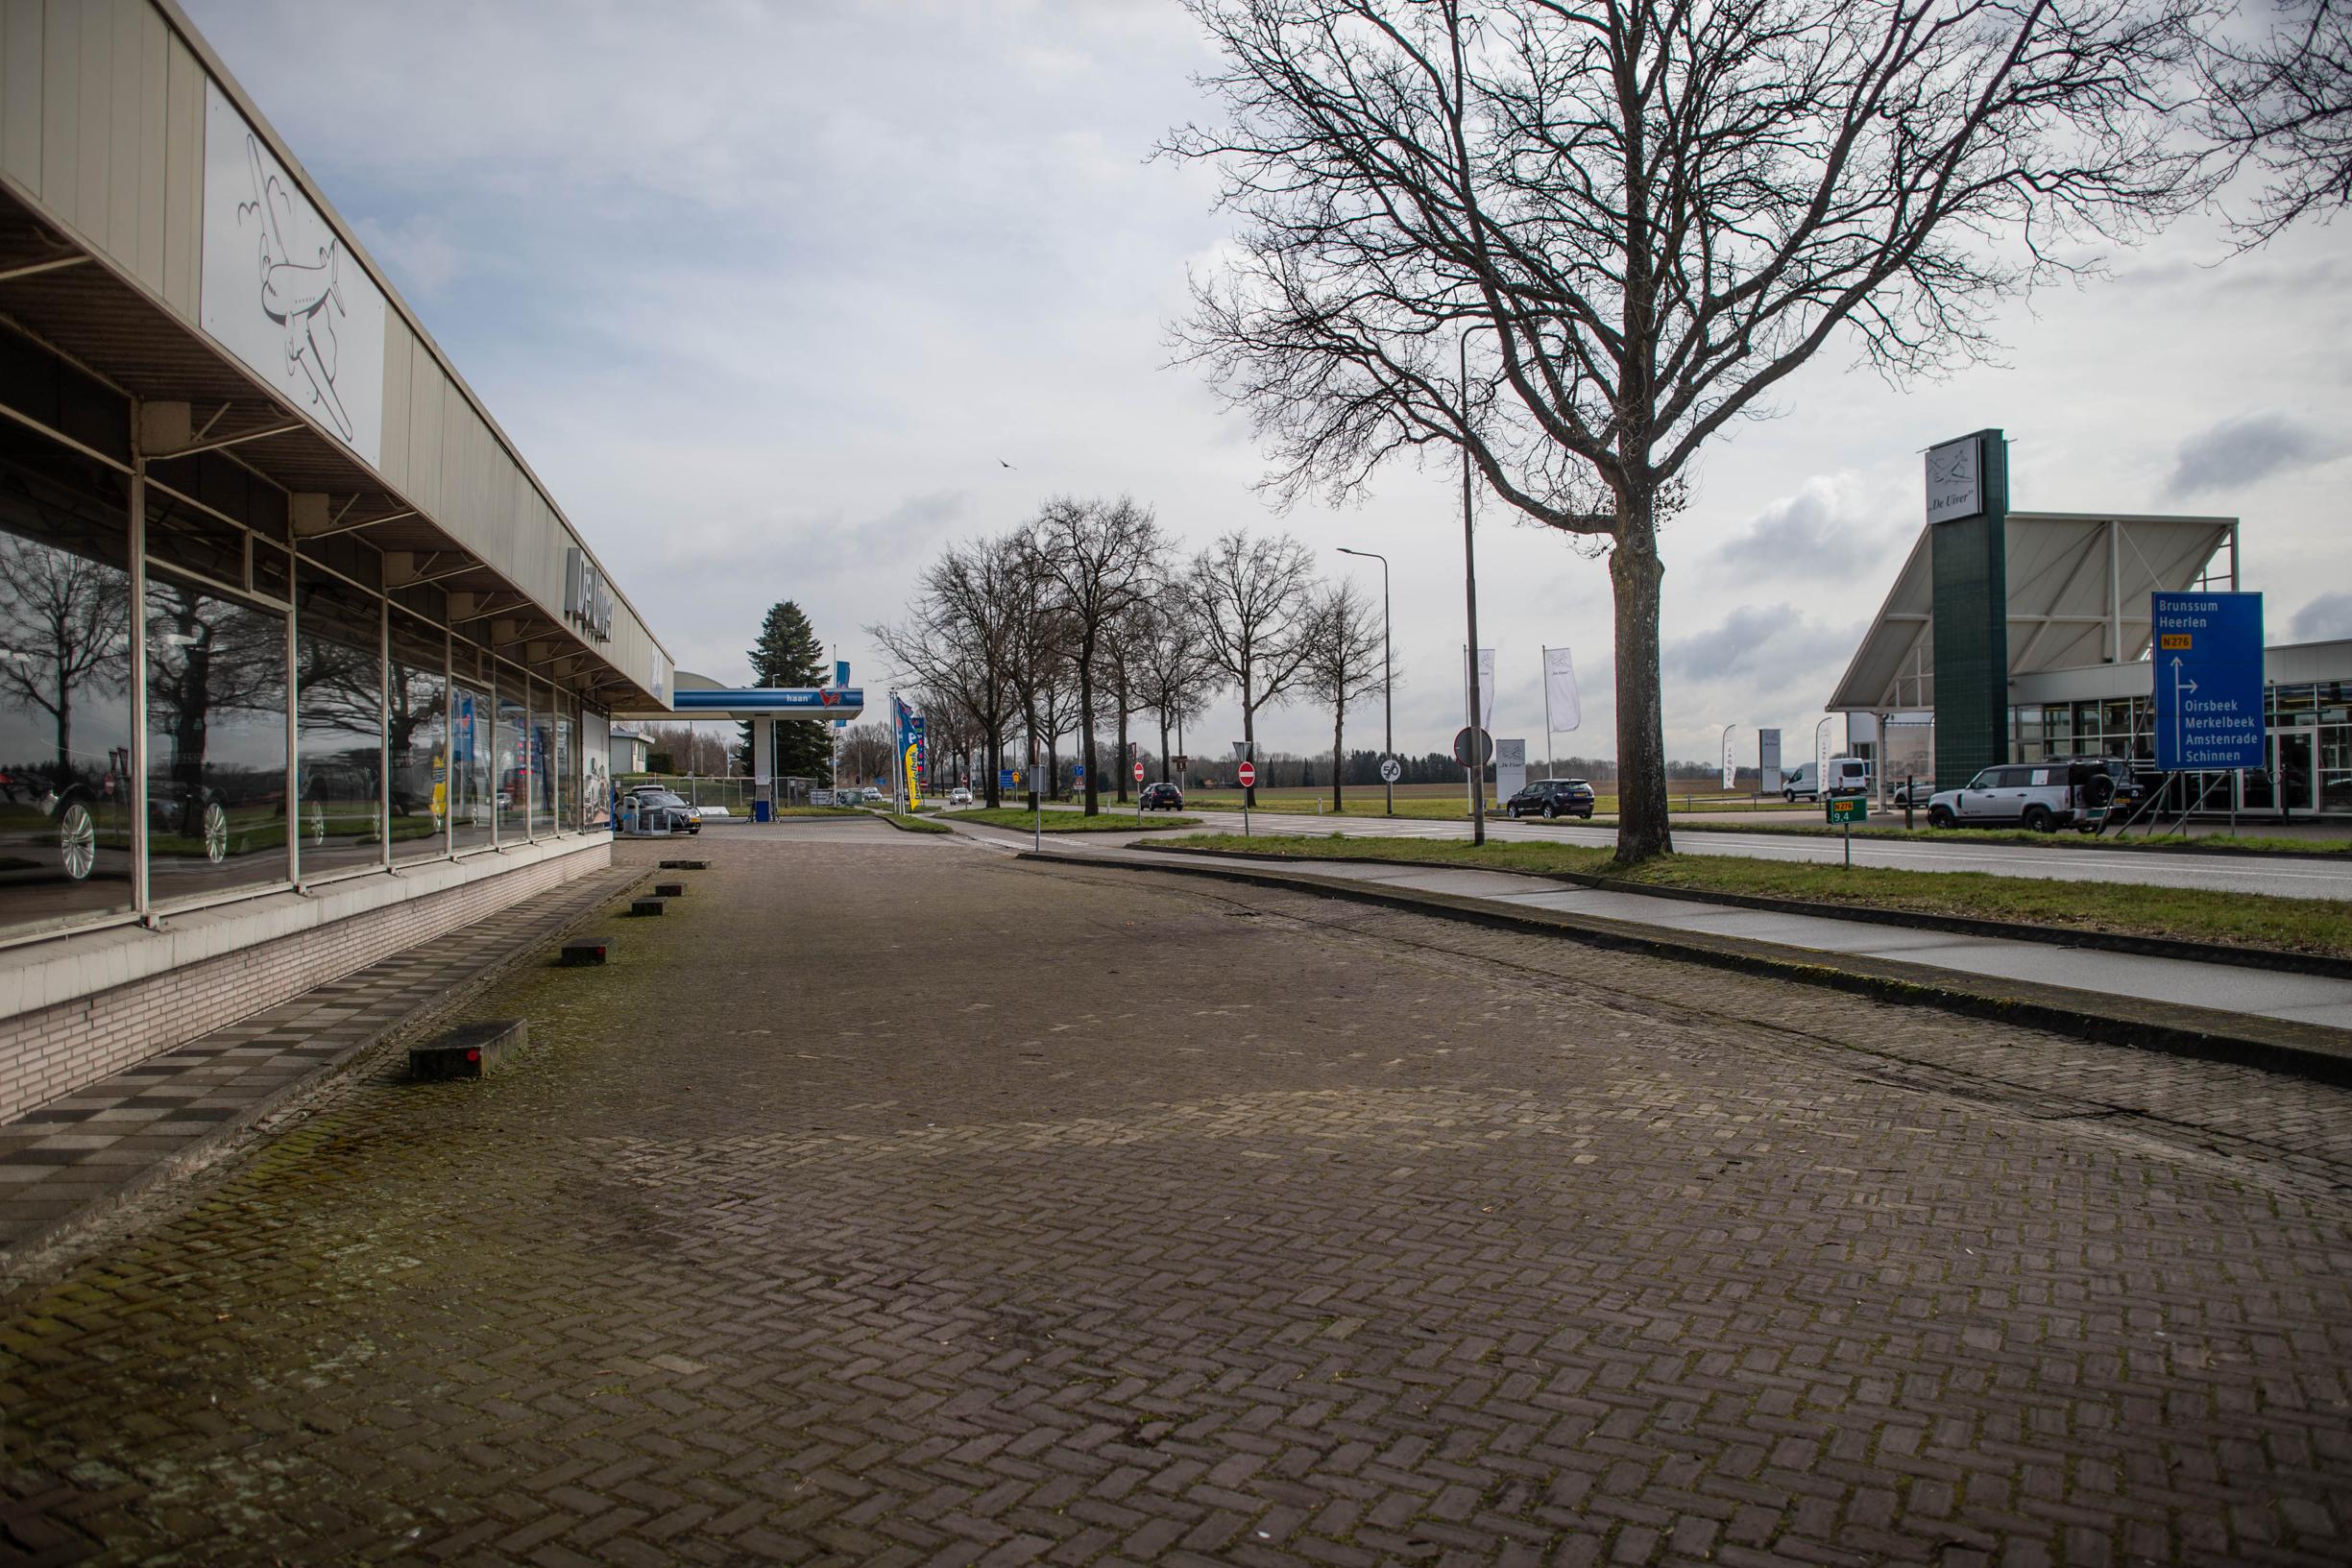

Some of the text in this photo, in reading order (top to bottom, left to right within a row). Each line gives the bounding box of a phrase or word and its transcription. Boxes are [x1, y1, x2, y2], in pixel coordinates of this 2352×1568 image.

[2159, 599, 2218, 612] Brunssum
[2159, 616, 2207, 628] Heerlen
[2163, 638, 2189, 646] N276
[2185, 700, 2238, 712] Oirsbeek
[2185, 715, 2255, 729] Merkelbeek
[2186, 733, 2258, 745] Amstenrade
[2186, 750, 2241, 762] Schinnen
[1383, 765, 1398, 776] 50
